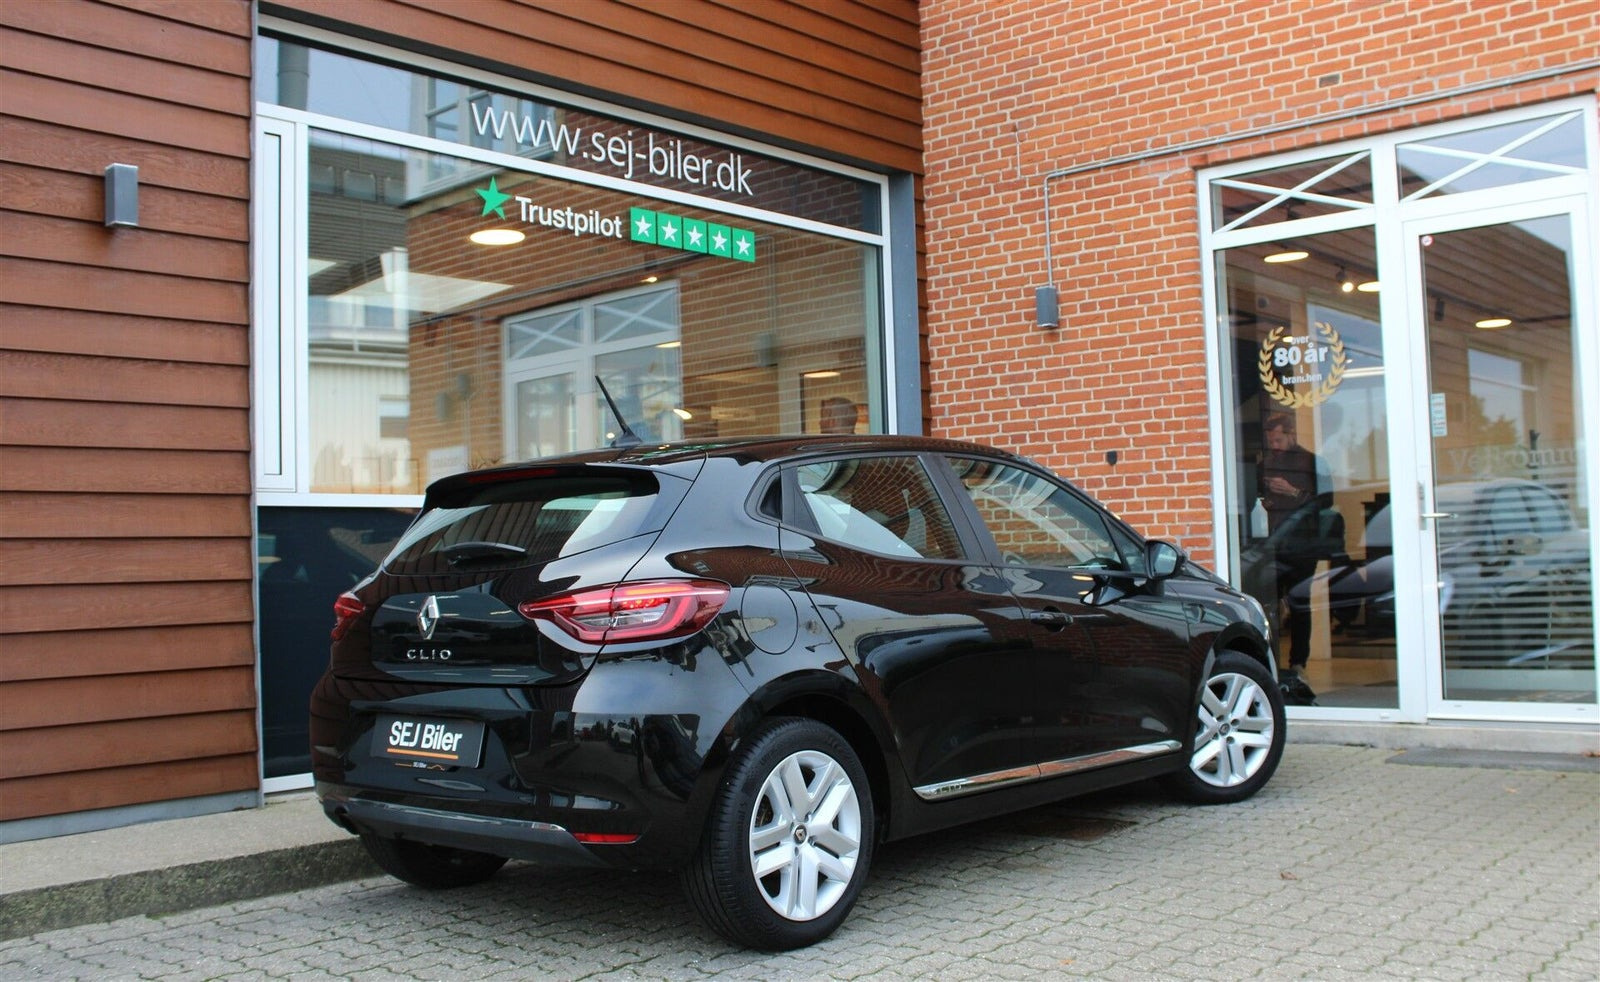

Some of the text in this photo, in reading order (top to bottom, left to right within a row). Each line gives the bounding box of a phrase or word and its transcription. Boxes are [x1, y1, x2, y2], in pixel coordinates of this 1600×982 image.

[471, 102, 753, 196] www.sej-biler.dk
[515, 195, 622, 239] Trustpilot
[1291, 336, 1309, 344] over
[1274, 342, 1328, 367] 80 år
[1282, 374, 1322, 385] branchen
[406, 649, 452, 660] CLIO
[389, 720, 463, 752] SEJ Biler
